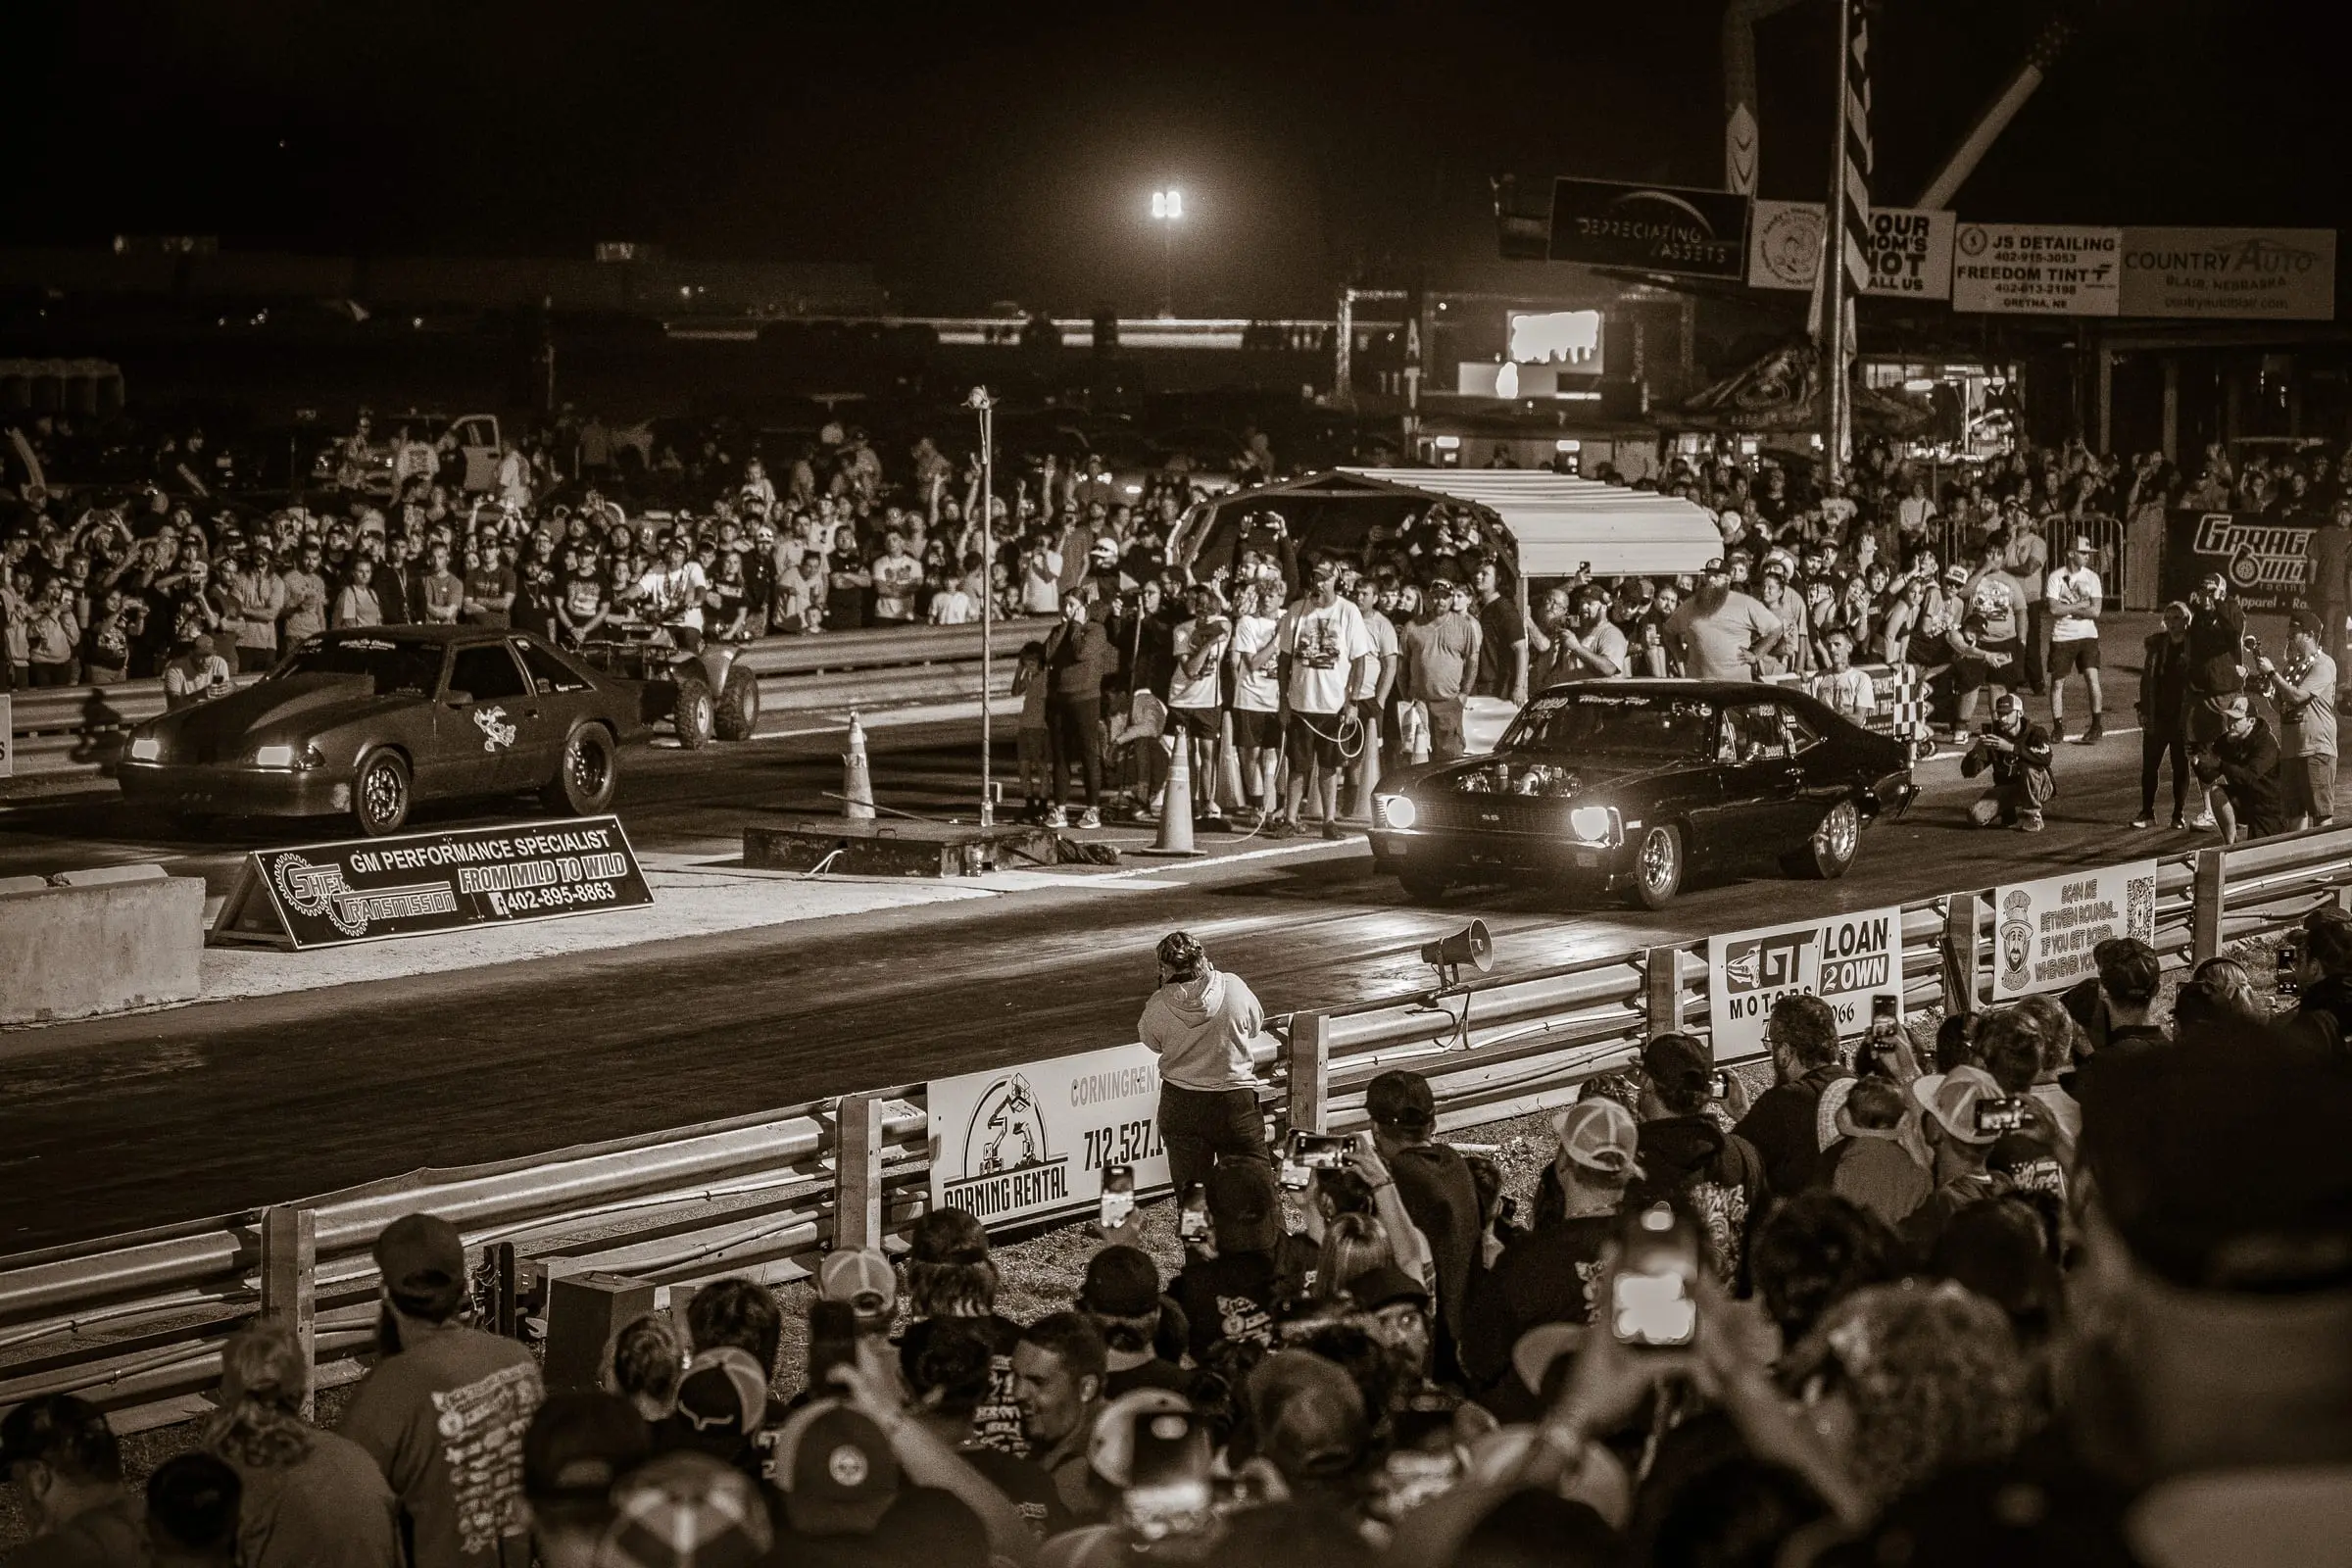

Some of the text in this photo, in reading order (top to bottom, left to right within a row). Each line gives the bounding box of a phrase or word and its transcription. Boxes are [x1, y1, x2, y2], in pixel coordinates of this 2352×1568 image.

[1992, 236, 2115, 252] JS DETAILING
[1956, 265, 2089, 282] FREEDOM TINT
[2124, 252, 2231, 270] COUNTRY
[1867, 276, 1899, 290] ALL
[2193, 513, 2317, 557] GARAG
[350, 829, 612, 874] GM PERFORMANCE SPECIALIST
[458, 852, 628, 895] FROM MILD TO WILD
[508, 881, 616, 910] 402-895-8863
[2061, 878, 2097, 905] SCAN ME
[2040, 906, 2079, 933] BETWEEN
[1823, 916, 1889, 960] LOAN
[2040, 936, 2051, 956] IF
[2051, 932, 2069, 955] YOU
[2070, 929, 2085, 951] GET
[1759, 928, 1819, 987] GT
[2034, 955, 2080, 982] WHENEVER
[1822, 956, 1887, 993] 2 OWN
[1013, 1165, 1069, 1208] RENTAL
